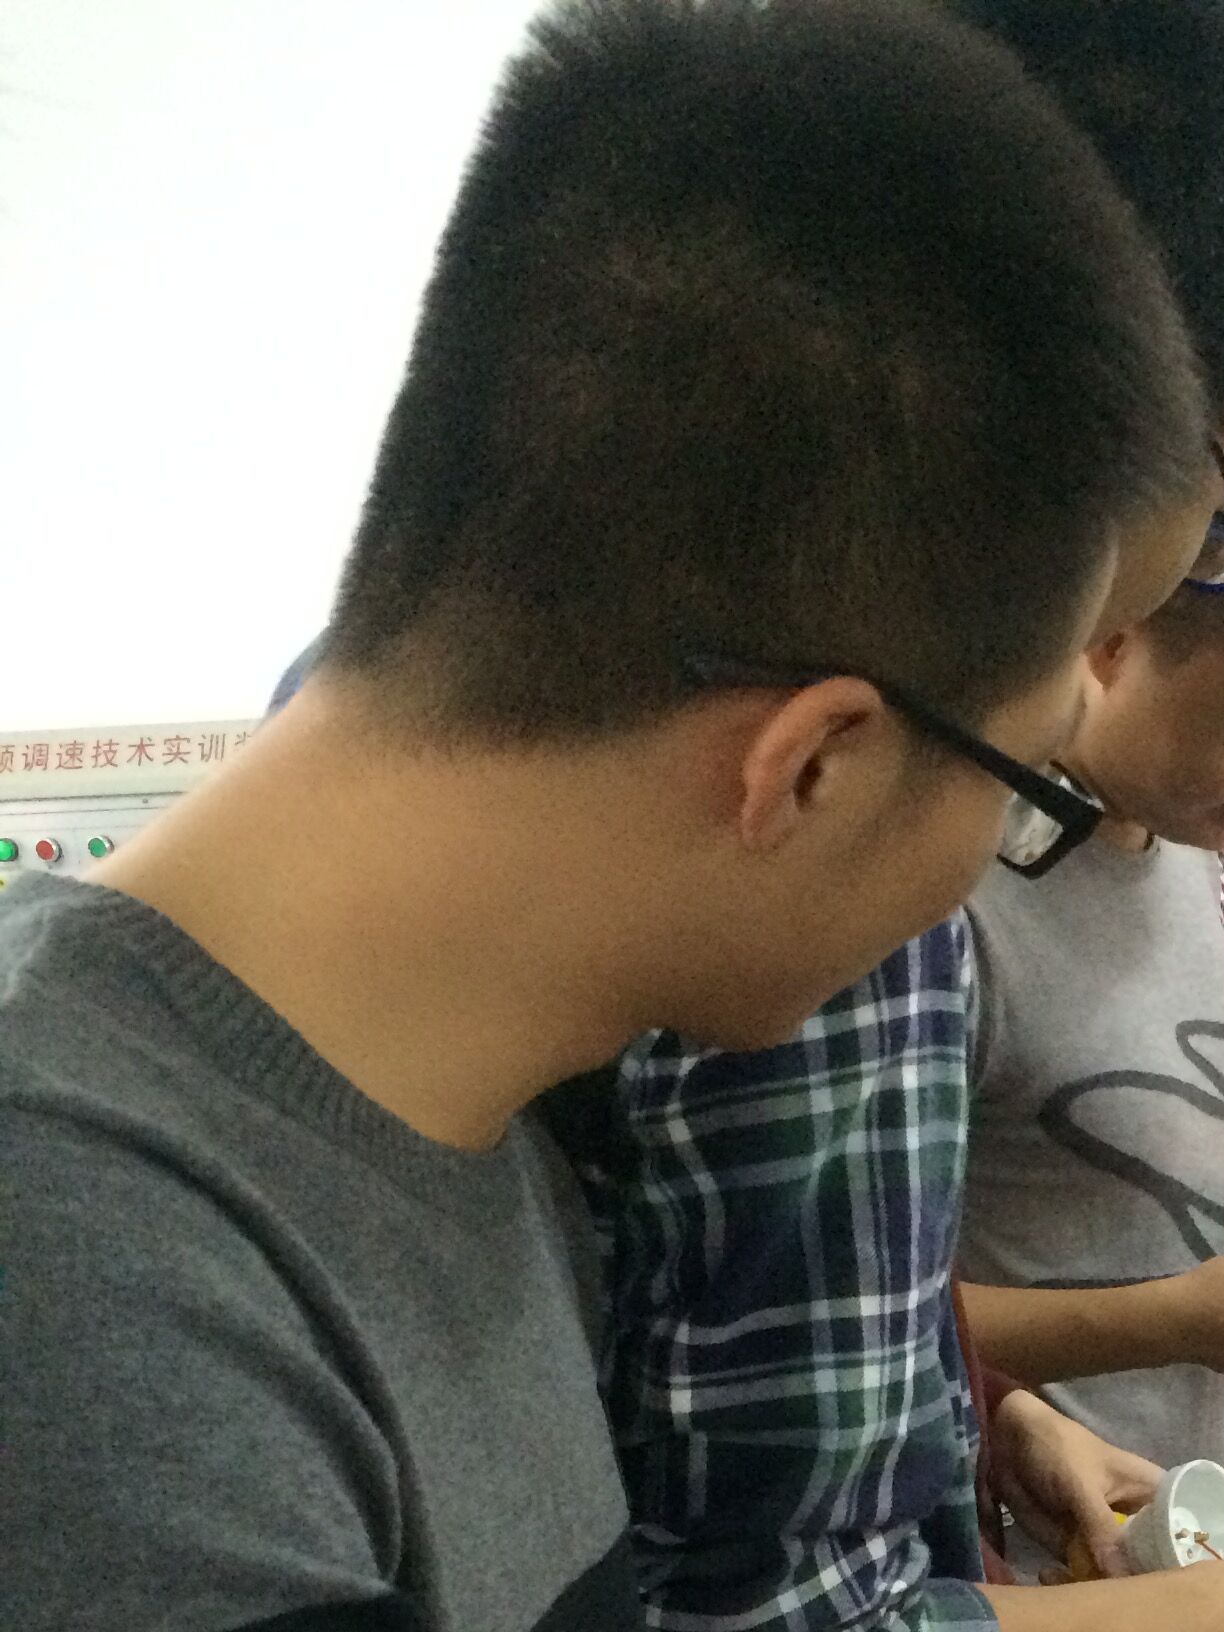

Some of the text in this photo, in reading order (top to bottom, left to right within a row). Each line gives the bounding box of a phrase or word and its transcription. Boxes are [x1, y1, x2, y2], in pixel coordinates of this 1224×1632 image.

[0, 731, 252, 773] 调速技术实训
